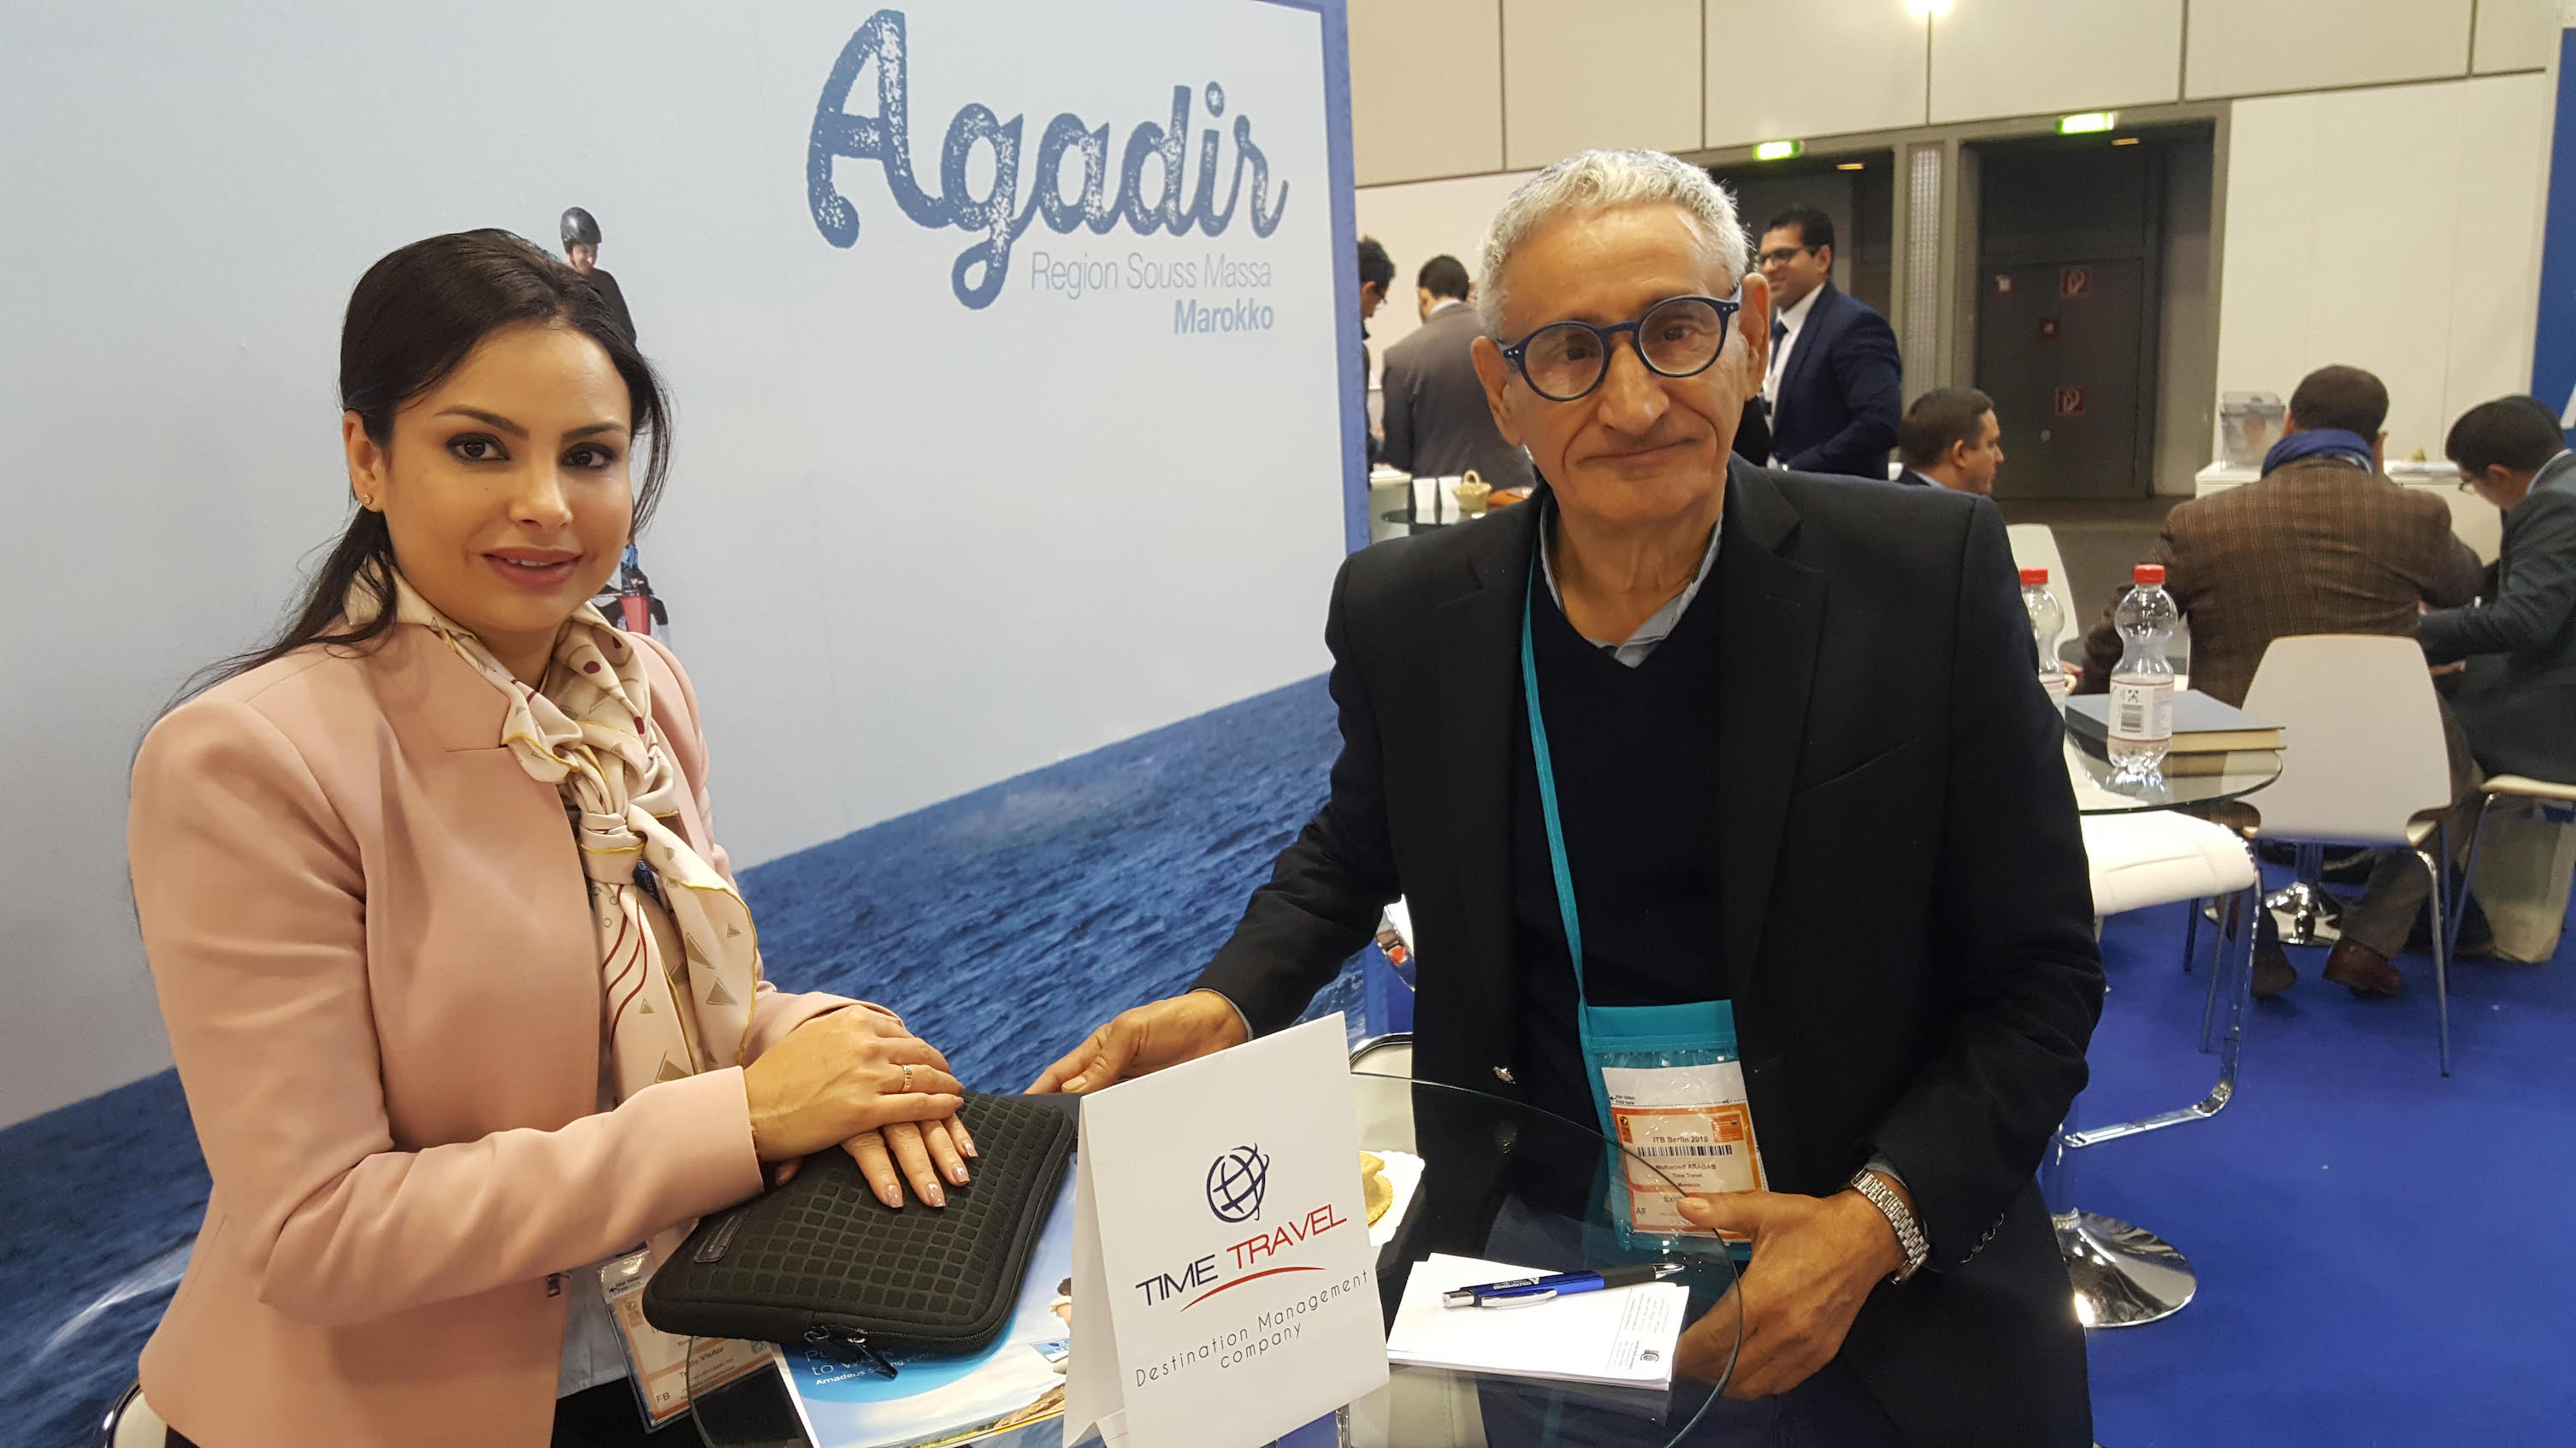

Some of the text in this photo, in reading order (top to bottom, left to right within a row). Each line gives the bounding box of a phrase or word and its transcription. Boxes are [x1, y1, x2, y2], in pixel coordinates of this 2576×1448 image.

[806, 9, 1288, 310] Agadir
[1031, 252, 1273, 300] Region Souss Massa
[1174, 299, 1273, 334] Marokko
[1136, 1204, 1347, 1306] TIME TRAVEL
[1136, 1270, 1368, 1387] Destination Management
[1220, 1323, 1302, 1369] company
[700, 1346, 725, 1361] Visitor
[812, 1364, 834, 1376] to
[656, 1392, 671, 1403] FB
[816, 1370, 866, 1385] Amadeus
